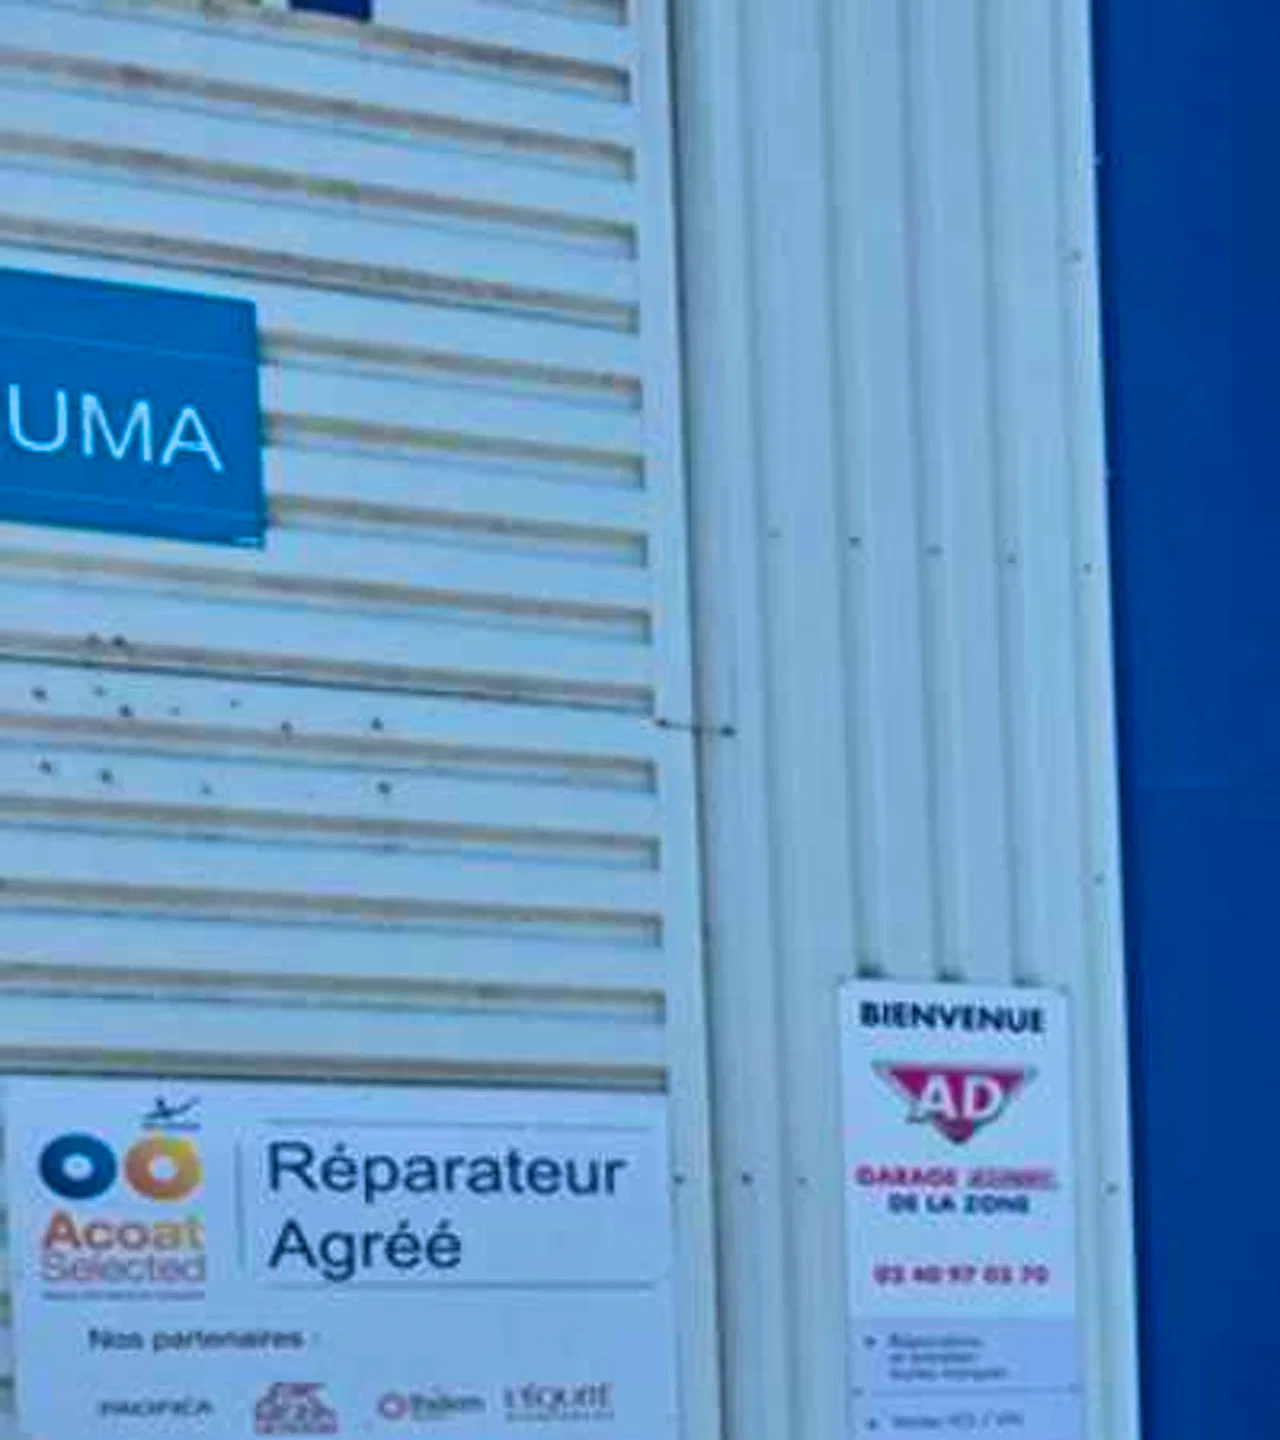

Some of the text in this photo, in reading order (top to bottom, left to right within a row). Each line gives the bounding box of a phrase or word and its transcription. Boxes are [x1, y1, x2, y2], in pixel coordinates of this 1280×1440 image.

[859, 1001, 1045, 1033] BIENVENUE
[917, 1074, 1001, 1118] AD
[267, 1141, 625, 1202] Réparateur
[855, 1165, 957, 1187] GARAGE
[888, 1193, 1030, 1214] DE LA ZONE
[44, 1209, 205, 1250] Acoat
[267, 1218, 464, 1282] Agréé
[44, 1253, 205, 1282] Selected
[88, 1326, 143, 1351] Nos
[152, 1328, 305, 1354] partenaires
